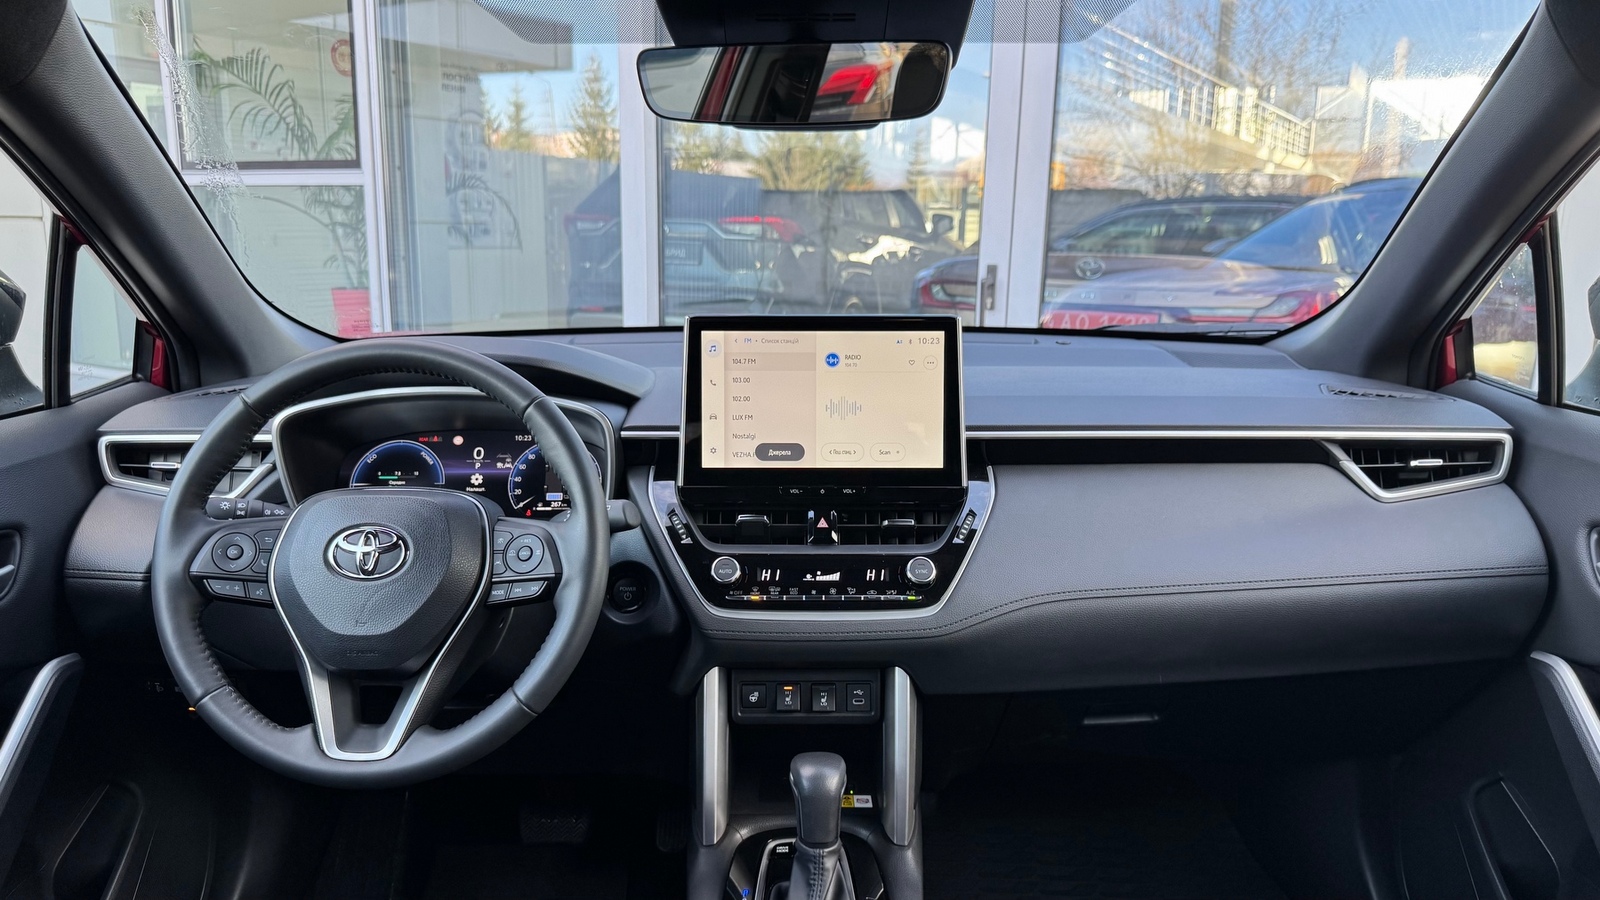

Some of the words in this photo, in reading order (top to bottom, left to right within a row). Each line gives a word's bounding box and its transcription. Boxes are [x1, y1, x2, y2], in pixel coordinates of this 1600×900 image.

[918, 337, 940, 345] 10:23
[473, 446, 485, 460] 0
[768, 448, 792, 457] Джерела
[366, 453, 378, 464] ECO
[474, 462, 481, 470] P
[761, 568, 780, 581] HI
[866, 568, 885, 581] HI
